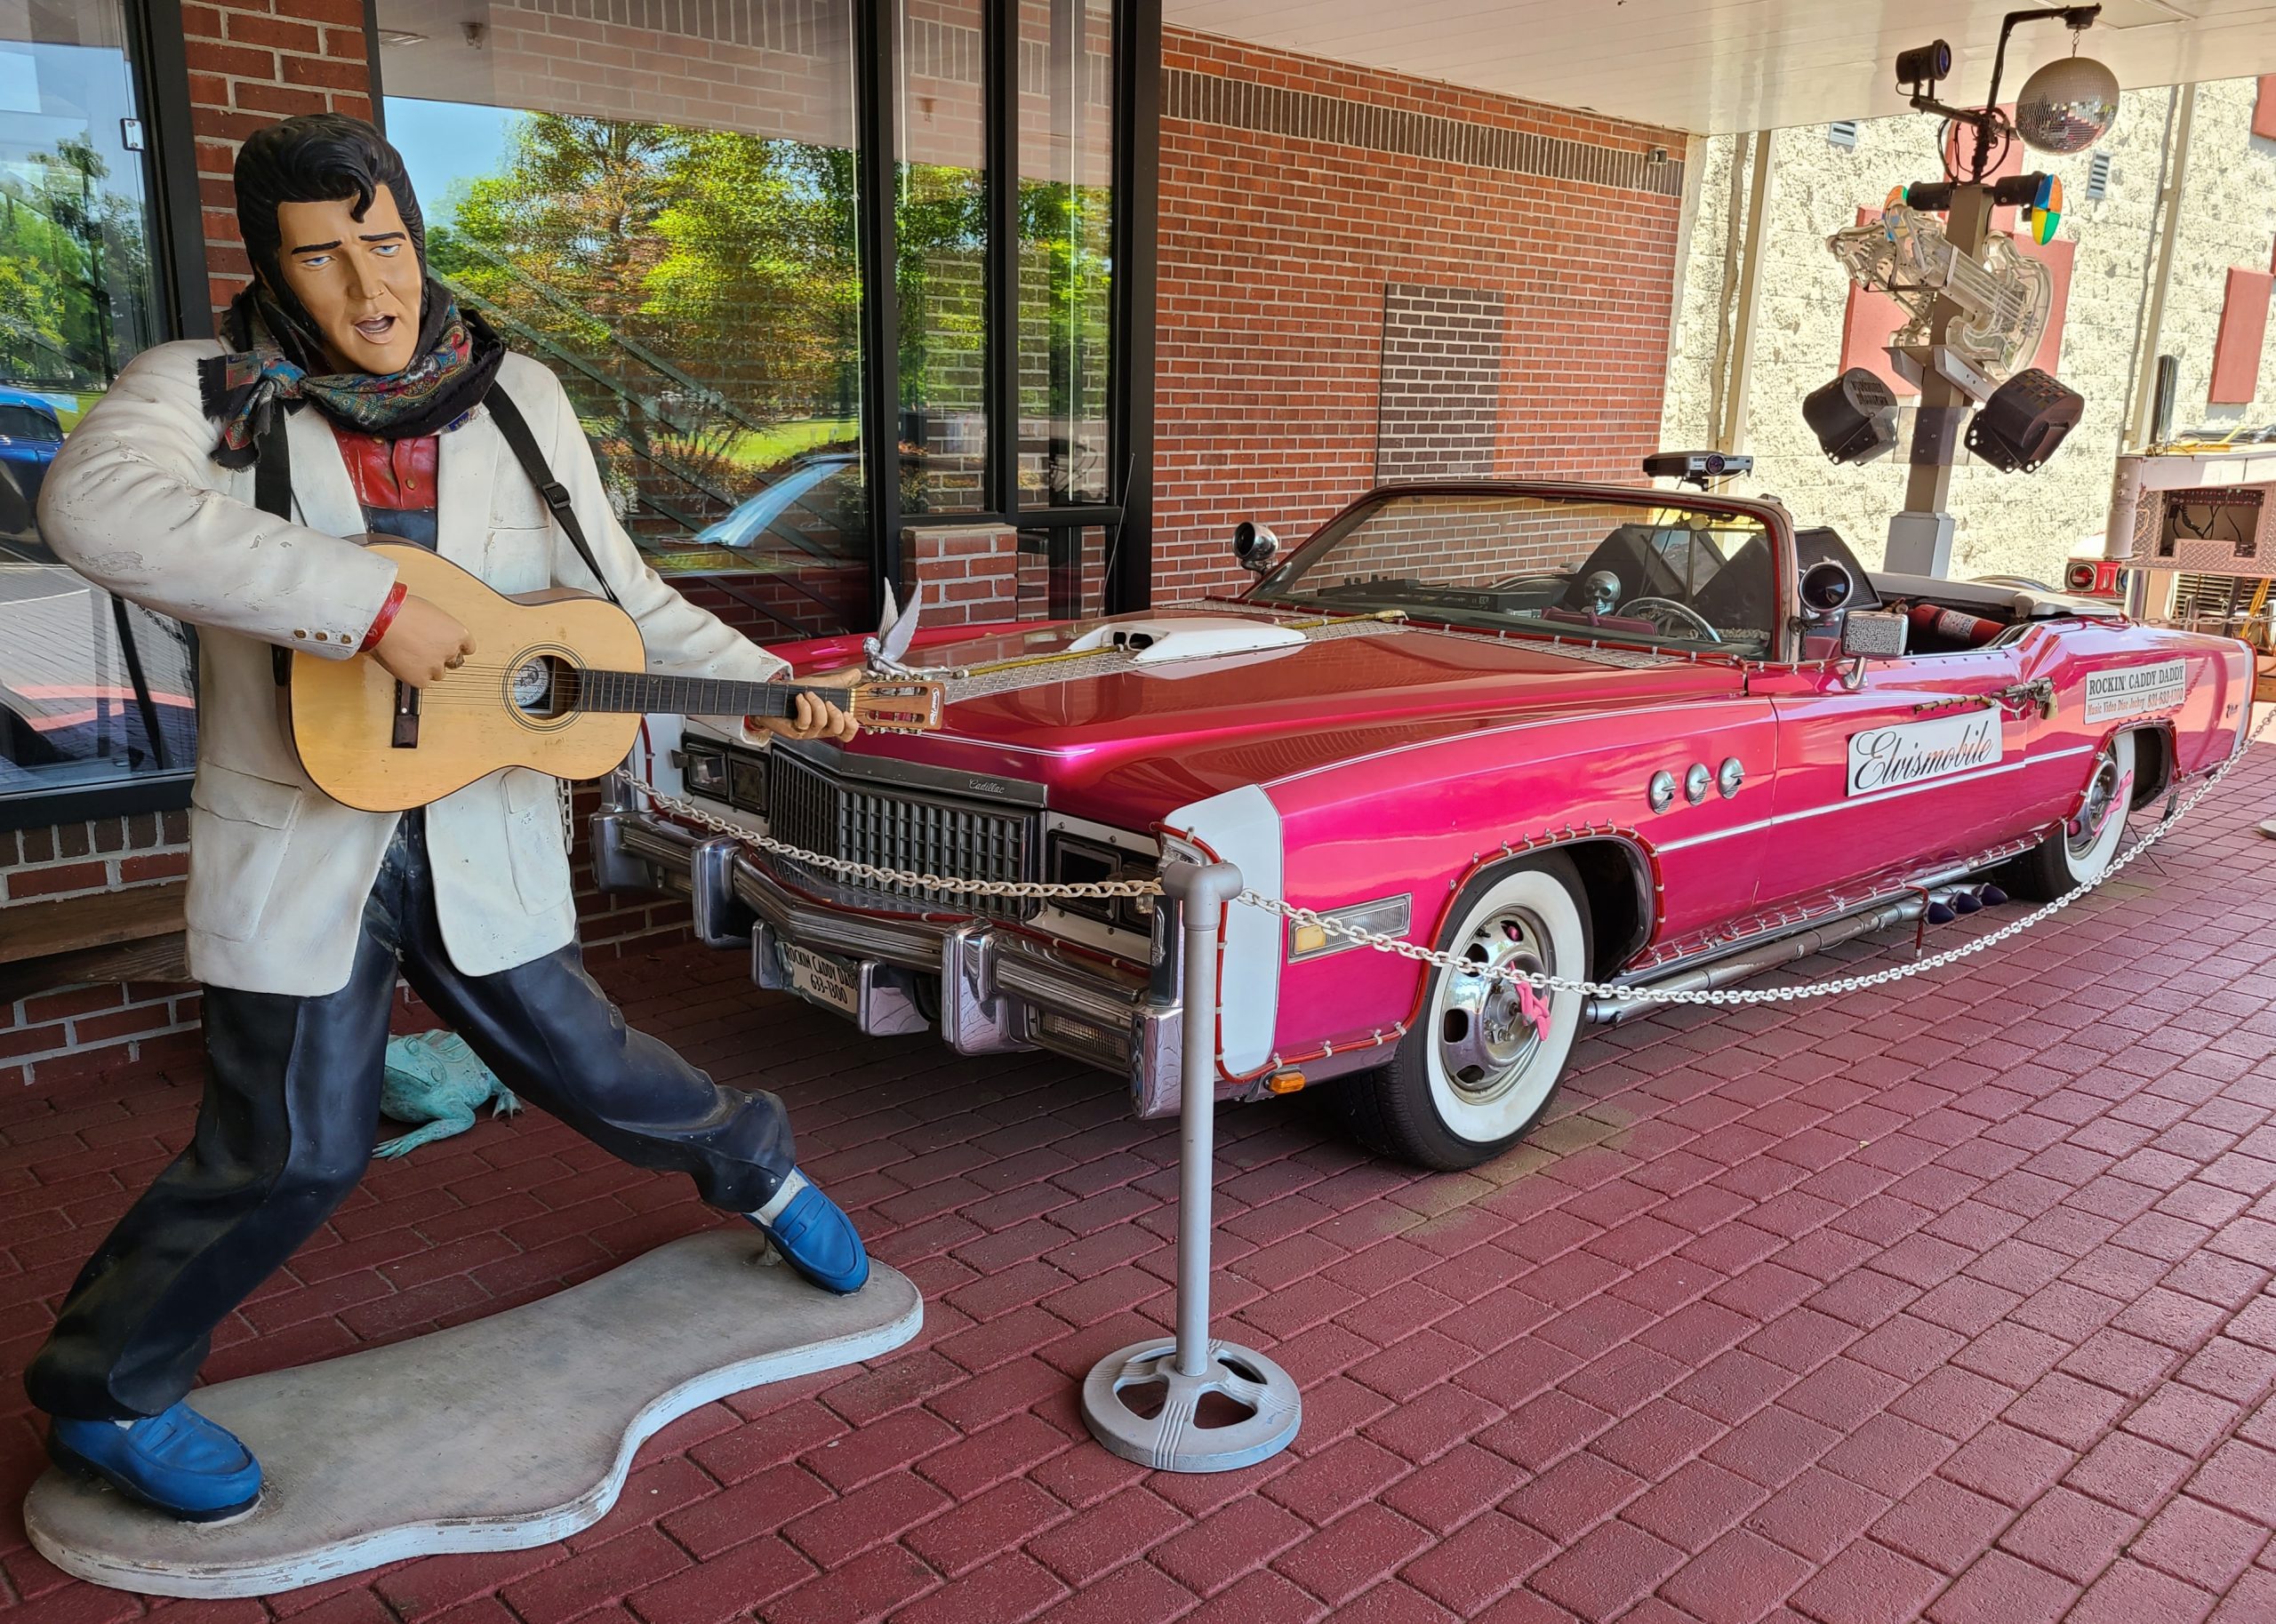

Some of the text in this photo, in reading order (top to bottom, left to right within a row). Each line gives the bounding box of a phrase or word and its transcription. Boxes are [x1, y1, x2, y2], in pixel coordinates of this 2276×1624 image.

[2088, 665, 2184, 695] ROCKIN' CADDY DADDY
[2087, 702, 2102, 716] Music
[2103, 700, 2117, 713] Video
[2118, 699, 2128, 711] Disc
[2129, 695, 2144, 710] Jockey
[1854, 720, 1994, 789] Elvismobile
[969, 778, 1005, 794] Cadillac
[810, 973, 848, 1004] 633-1300
[812, 956, 837, 981] CADDY
[837, 967, 859, 991] DADD
